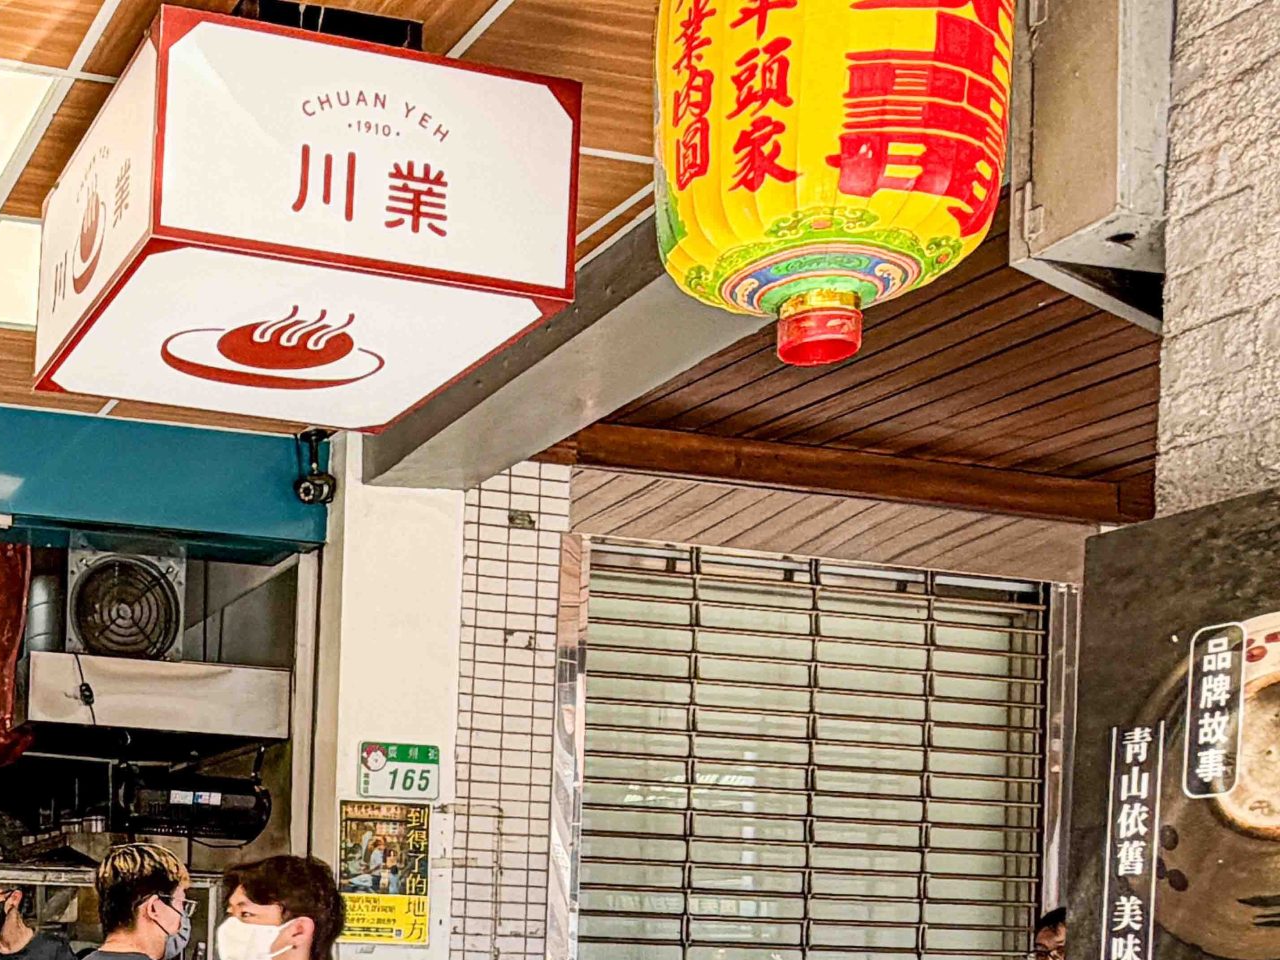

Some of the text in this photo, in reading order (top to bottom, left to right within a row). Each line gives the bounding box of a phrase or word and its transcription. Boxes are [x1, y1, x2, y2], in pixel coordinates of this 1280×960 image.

[302, 91, 450, 143] CHUAN YEH
[292, 143, 449, 238] 川業
[1195, 636, 1232, 784] 品牌故事
[387, 767, 432, 792] 165
[1116, 727, 1153, 878] 青山依舊
[405, 806, 429, 942] 到得了的地方
